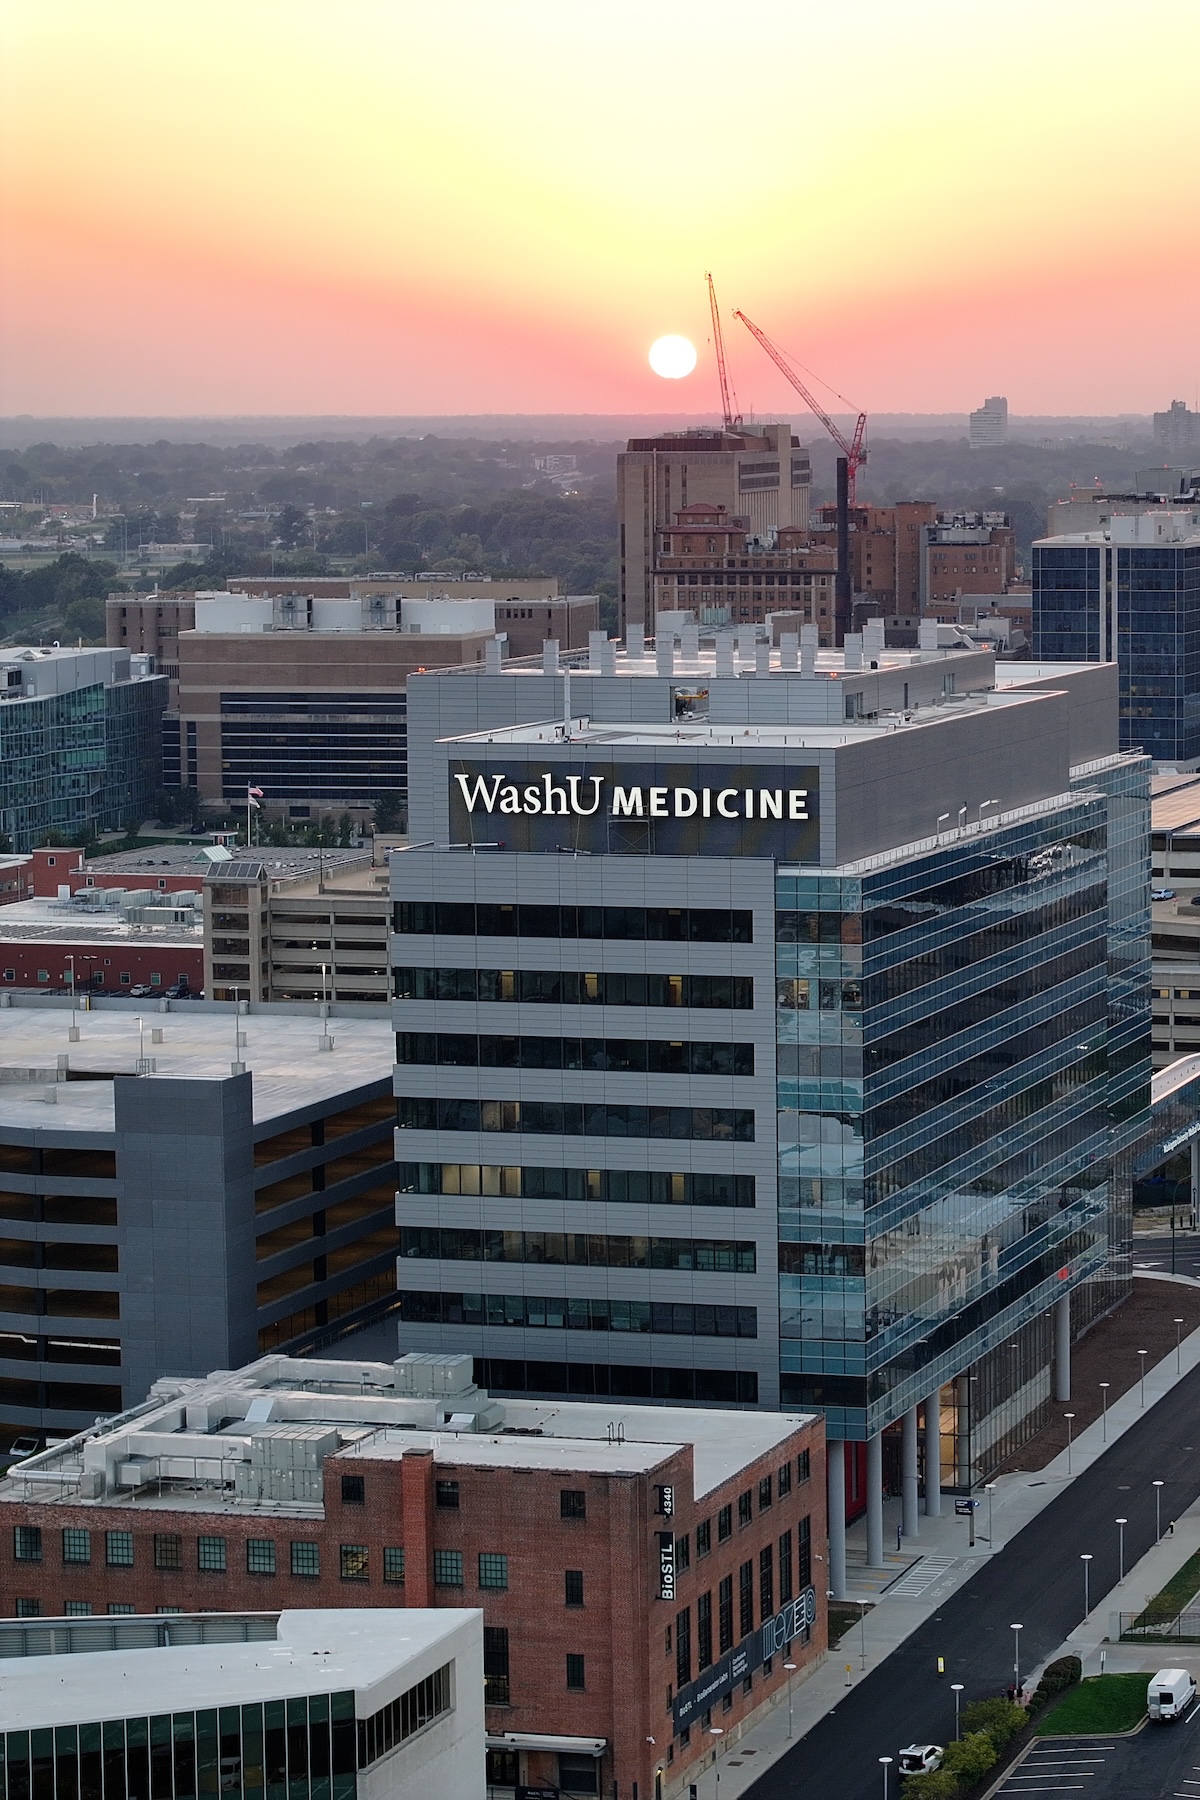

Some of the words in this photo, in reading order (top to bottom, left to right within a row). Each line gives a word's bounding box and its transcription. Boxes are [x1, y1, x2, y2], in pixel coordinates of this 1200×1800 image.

[454, 773, 605, 815] WashU
[611, 786, 809, 819] MEDICINE
[663, 1487, 672, 1514] 4340
[661, 1544, 673, 1599] BioSTL
